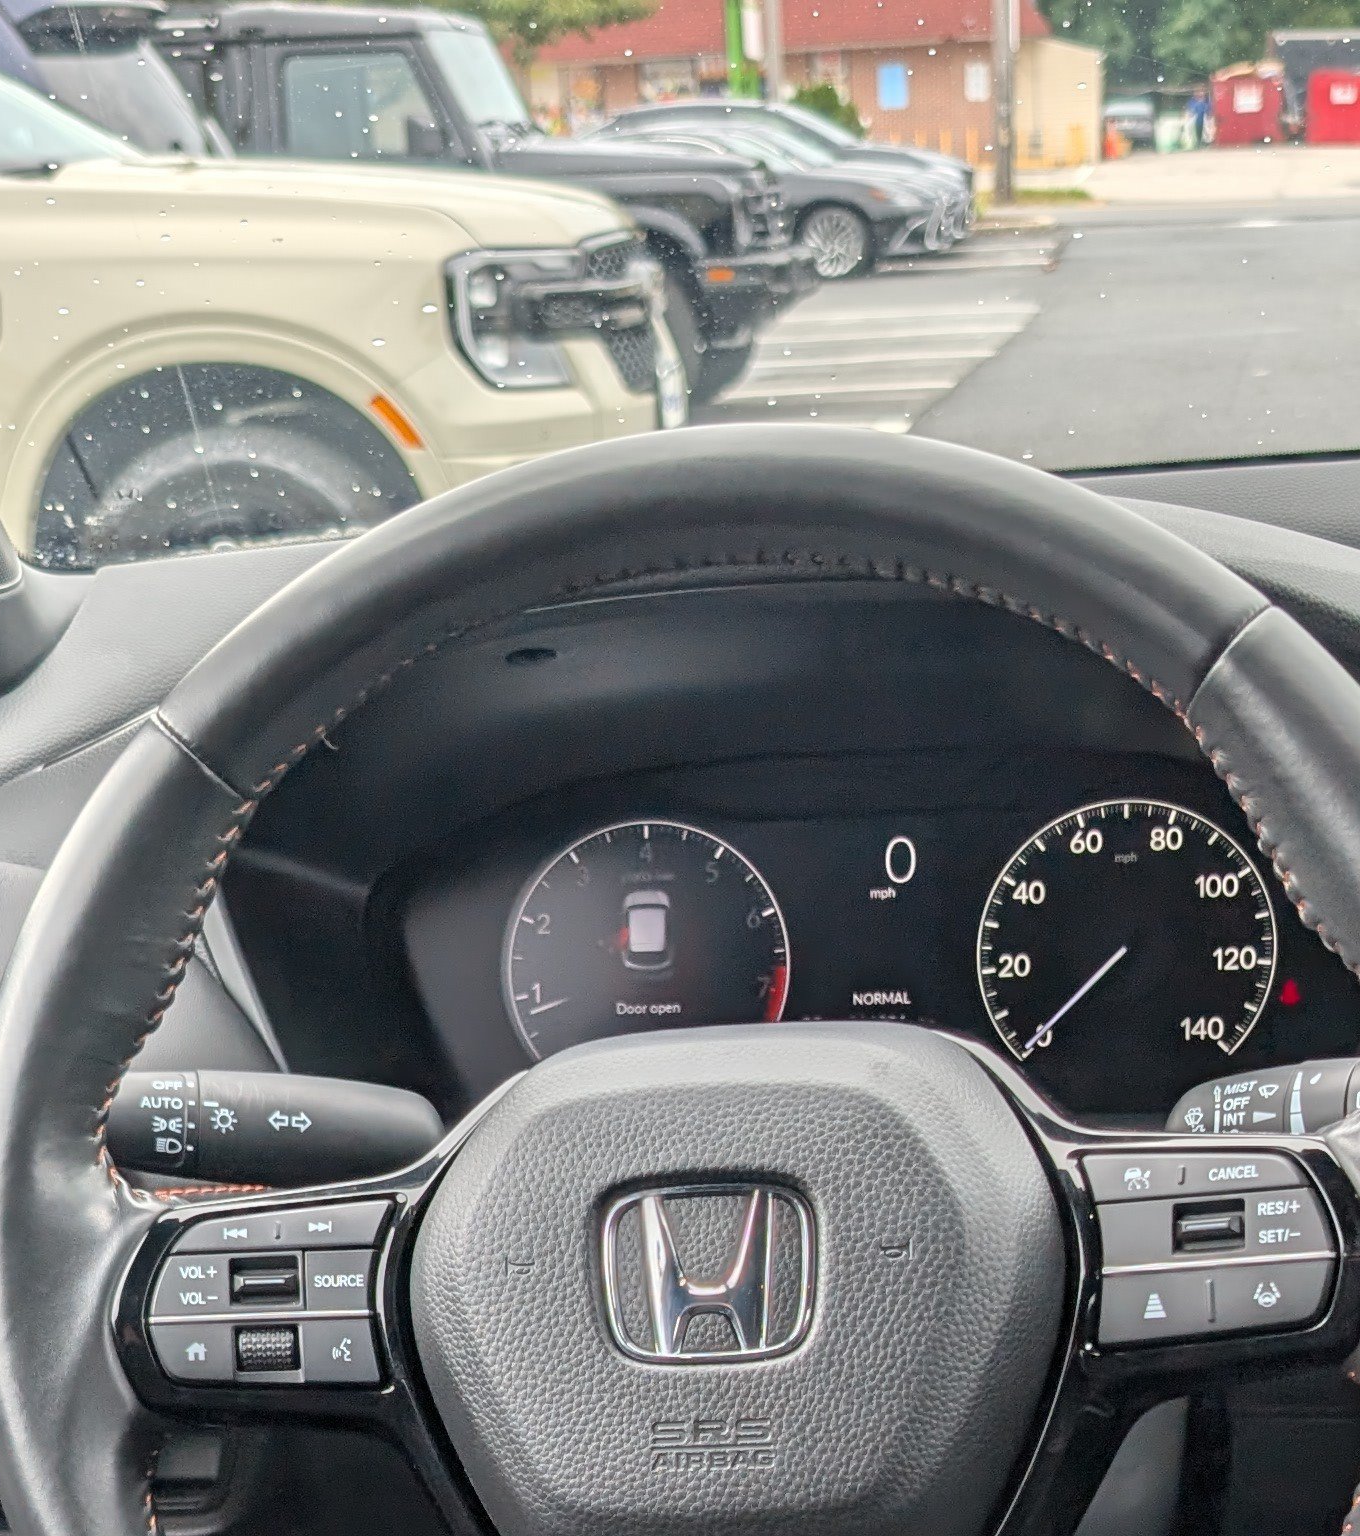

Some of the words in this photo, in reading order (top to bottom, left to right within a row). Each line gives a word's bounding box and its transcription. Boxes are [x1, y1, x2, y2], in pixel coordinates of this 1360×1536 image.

[1069, 828, 1104, 855] 60
[1149, 826, 1183, 852] 80
[884, 835, 917, 884] 0
[1113, 851, 1138, 864] mph
[705, 861, 720, 884] 5
[869, 886, 896, 901] mph
[1011, 880, 1046, 906] 40
[1194, 873, 1240, 899] 100
[536, 913, 551, 935] 2
[746, 908, 762, 930] 6
[997, 953, 1031, 979] 20
[1211, 946, 1257, 971] 120
[530, 981, 542, 1004] 1
[852, 991, 912, 1006] NORMAL
[615, 1002, 648, 1016] Door
[649, 1002, 682, 1018] open
[1179, 1015, 1225, 1042] 140
[152, 1079, 183, 1091] OFF
[1223, 1080, 1258, 1096] MIST
[140, 1097, 184, 1110] AUTO
[1222, 1097, 1250, 1112] OFF
[1222, 1111, 1246, 1127] INT
[1208, 1164, 1259, 1182] CANCEL
[1256, 1200, 1302, 1217] RES/+
[313, 1273, 365, 1289] SOURCE
[650, 1417, 774, 1447] SRS
[650, 1450, 777, 1473] AIRBAG
